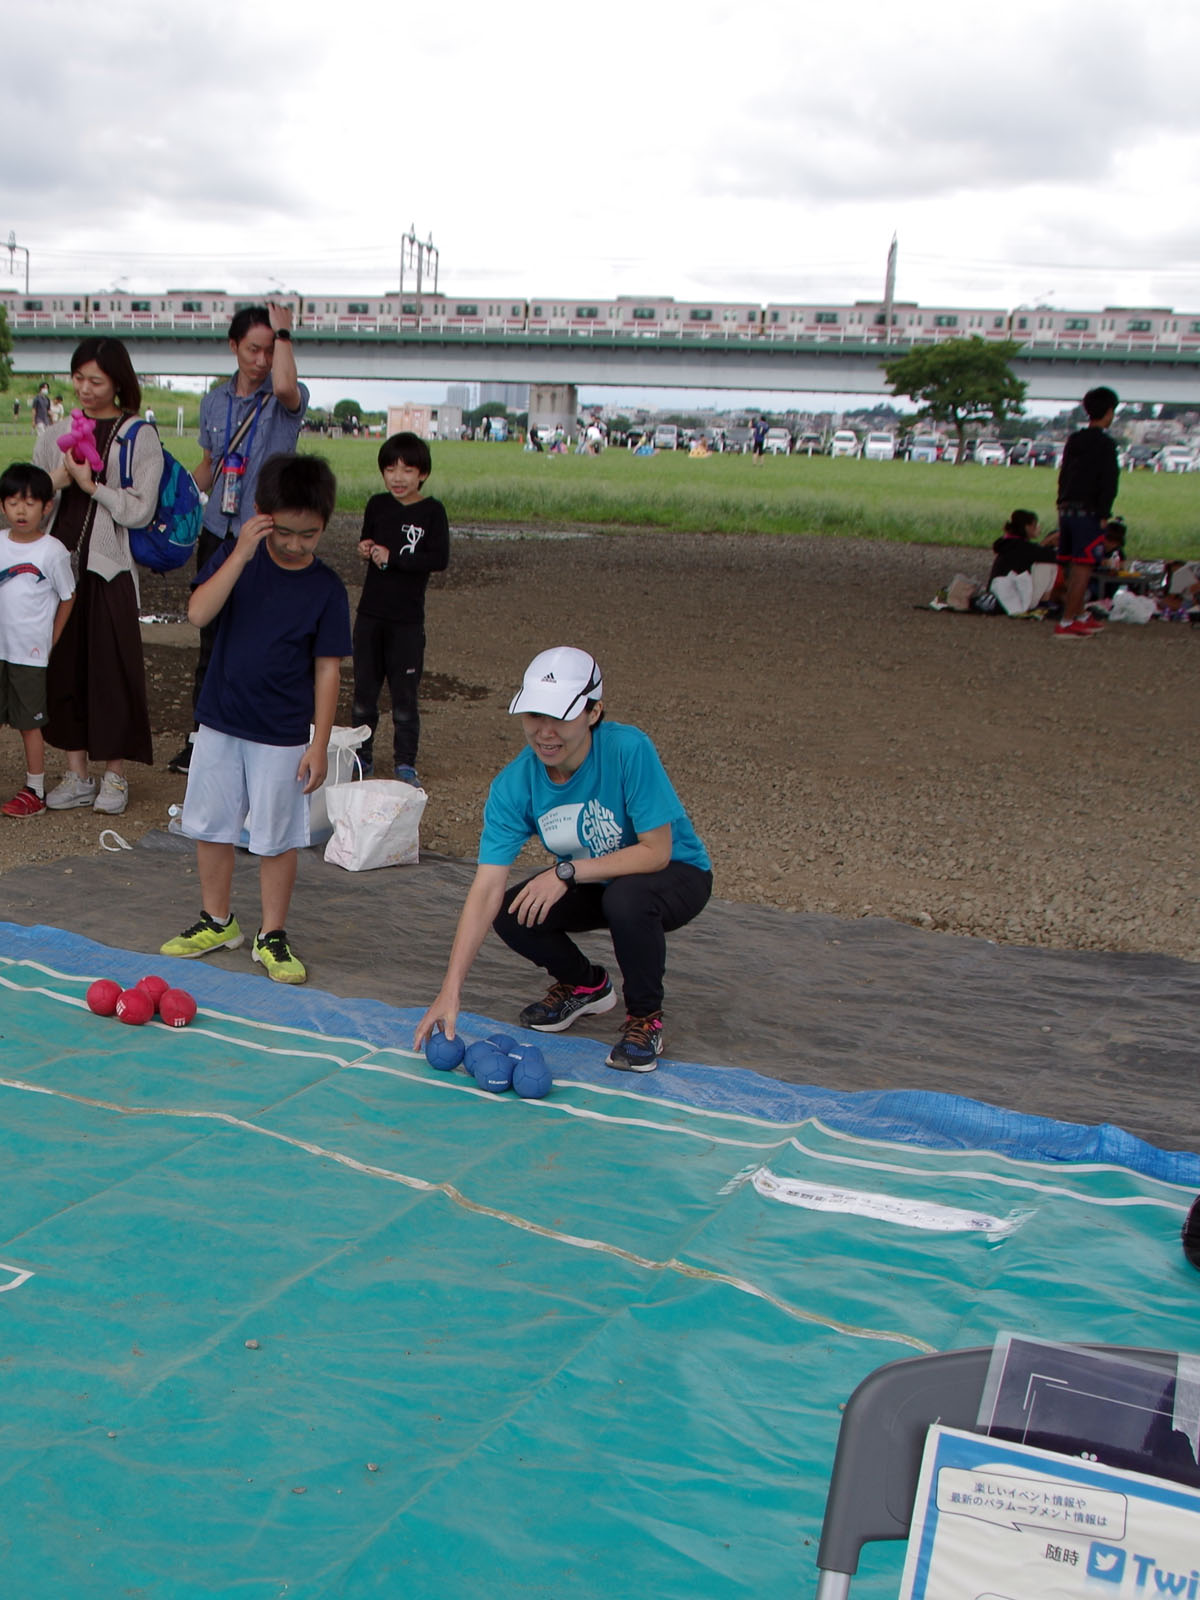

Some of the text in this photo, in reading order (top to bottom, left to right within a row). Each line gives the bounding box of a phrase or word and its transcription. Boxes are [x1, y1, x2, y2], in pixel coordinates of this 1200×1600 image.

[583, 798, 614, 820] A NEW
[974, 1482, 1086, 1509] 楽しいイベント情報や
[1045, 1543, 1200, 1600] 随時 Twi
